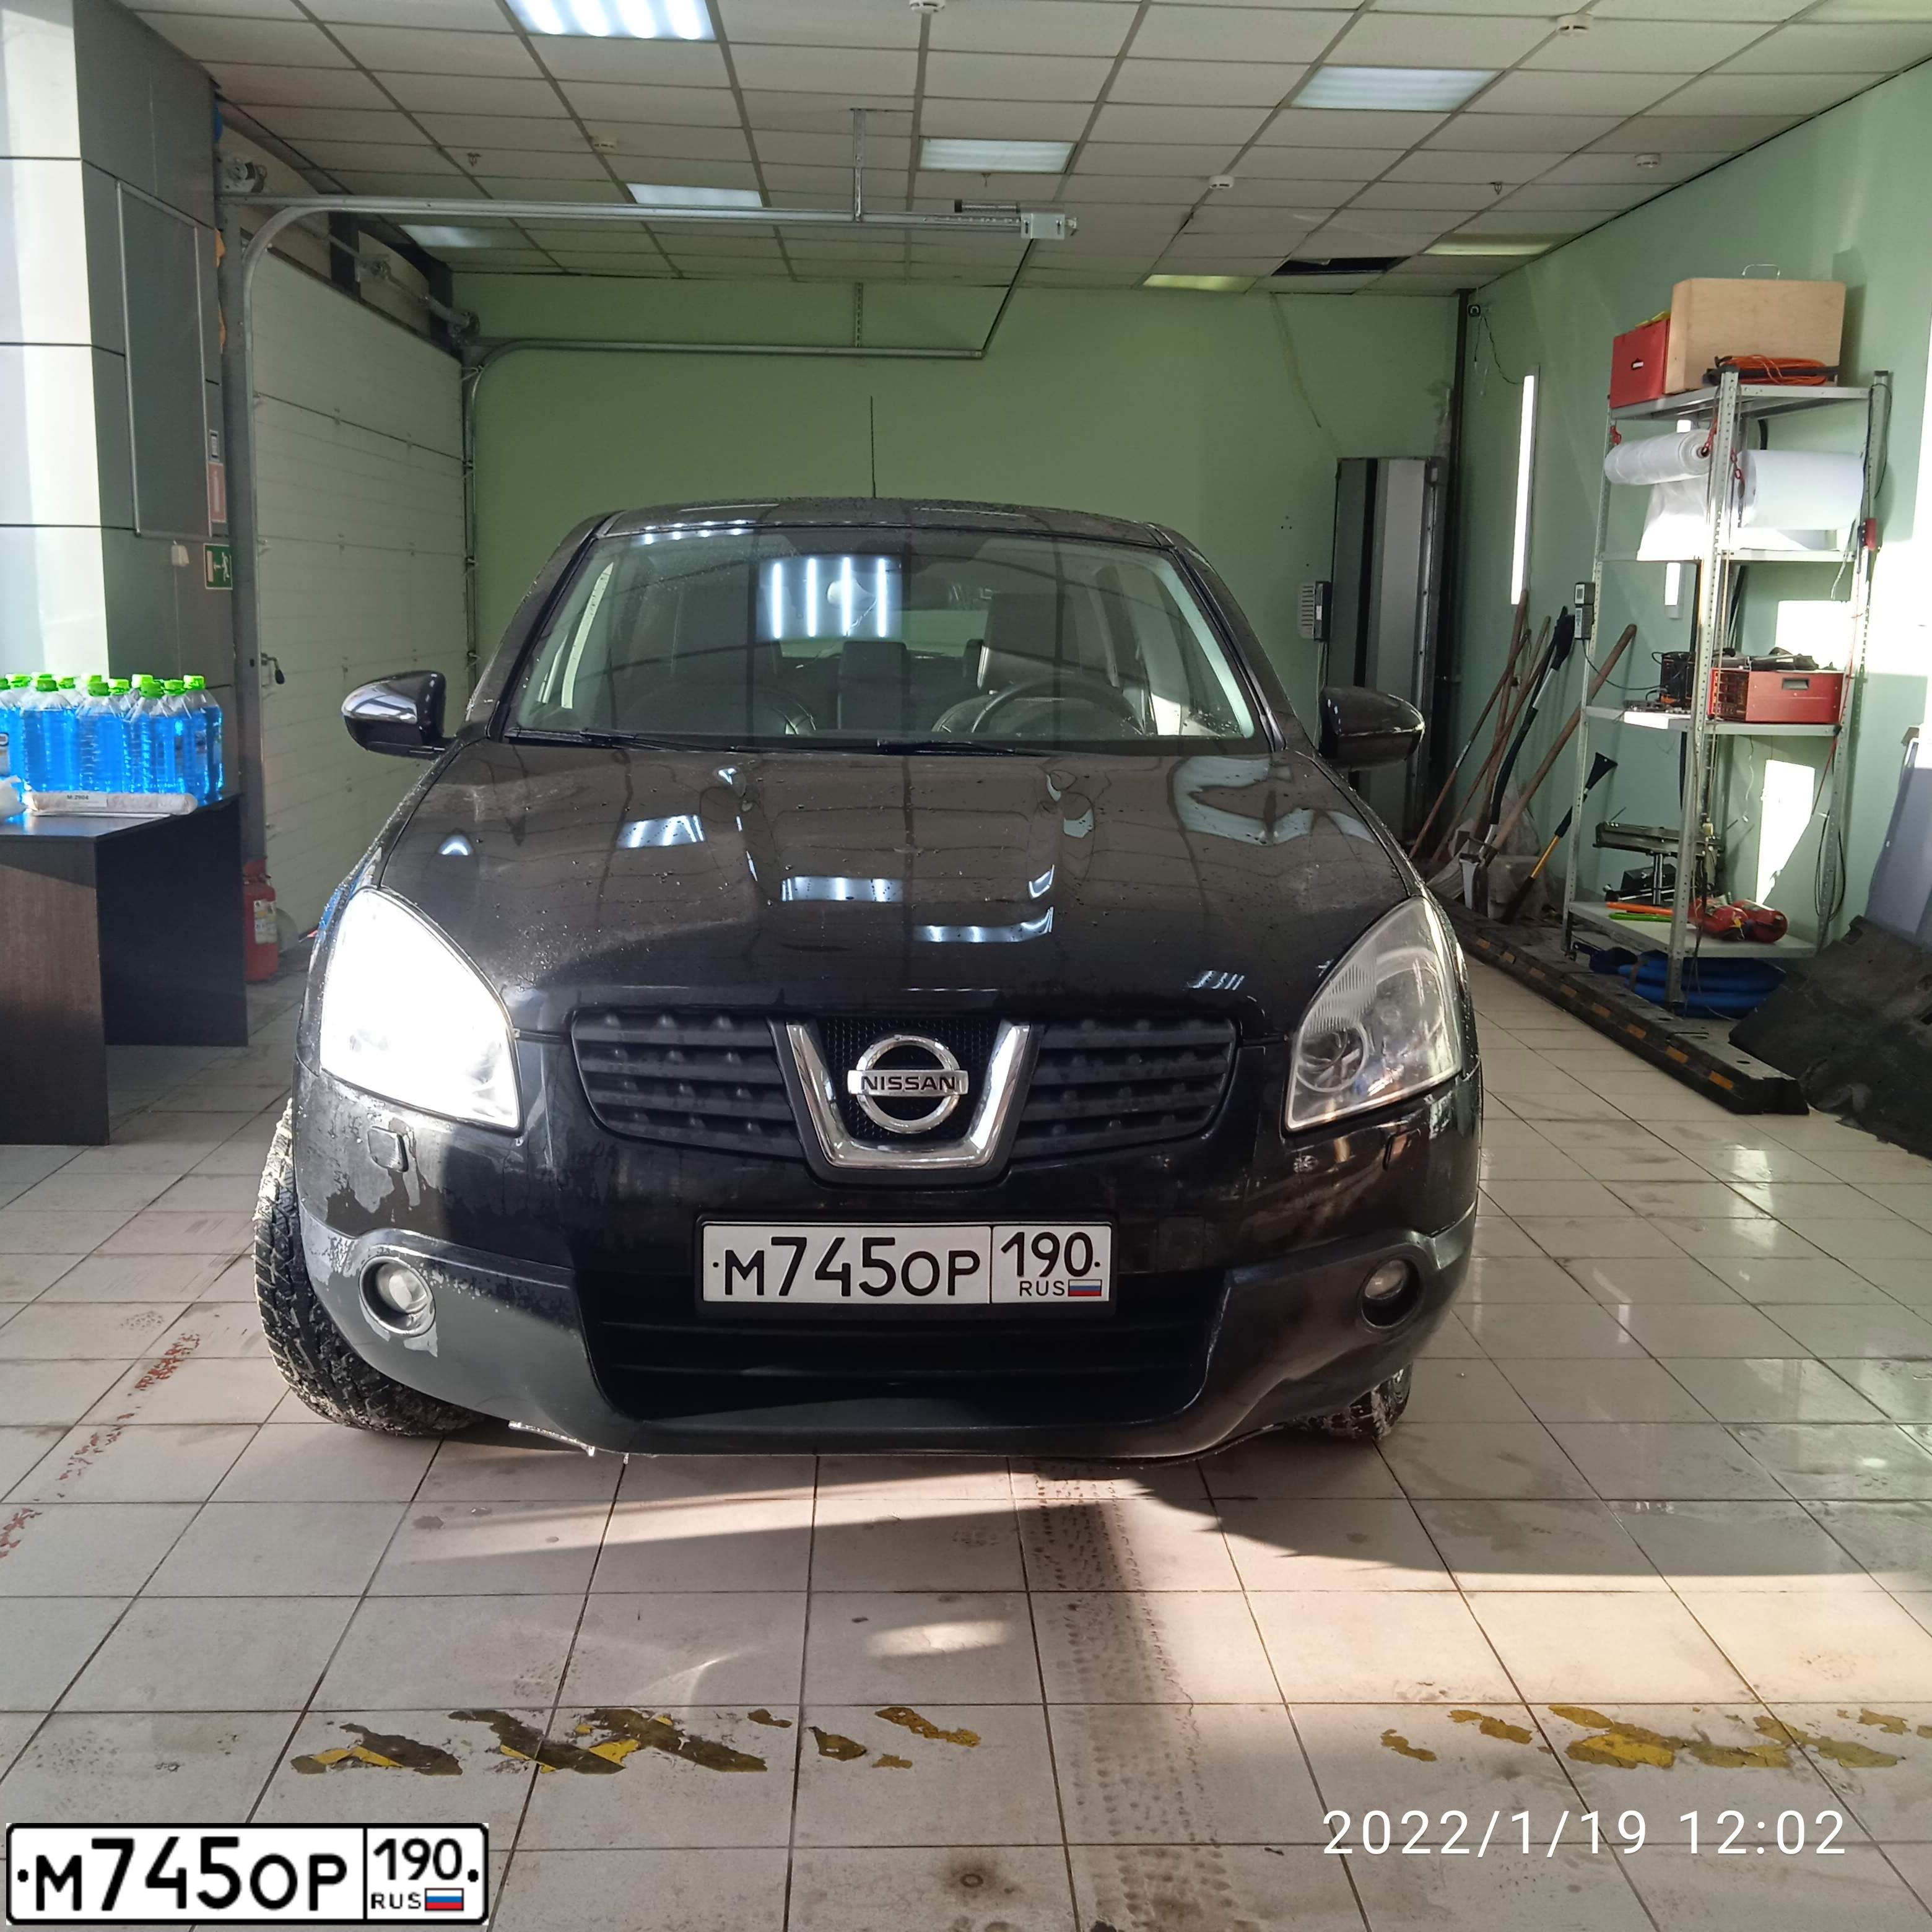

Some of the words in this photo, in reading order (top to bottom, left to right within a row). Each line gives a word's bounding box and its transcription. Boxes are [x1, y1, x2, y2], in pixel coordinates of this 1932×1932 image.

[861, 1076, 955, 1091] NISSAN
[1001, 1232, 1094, 1277] 190
[1019, 1279, 1065, 1297] RUS
